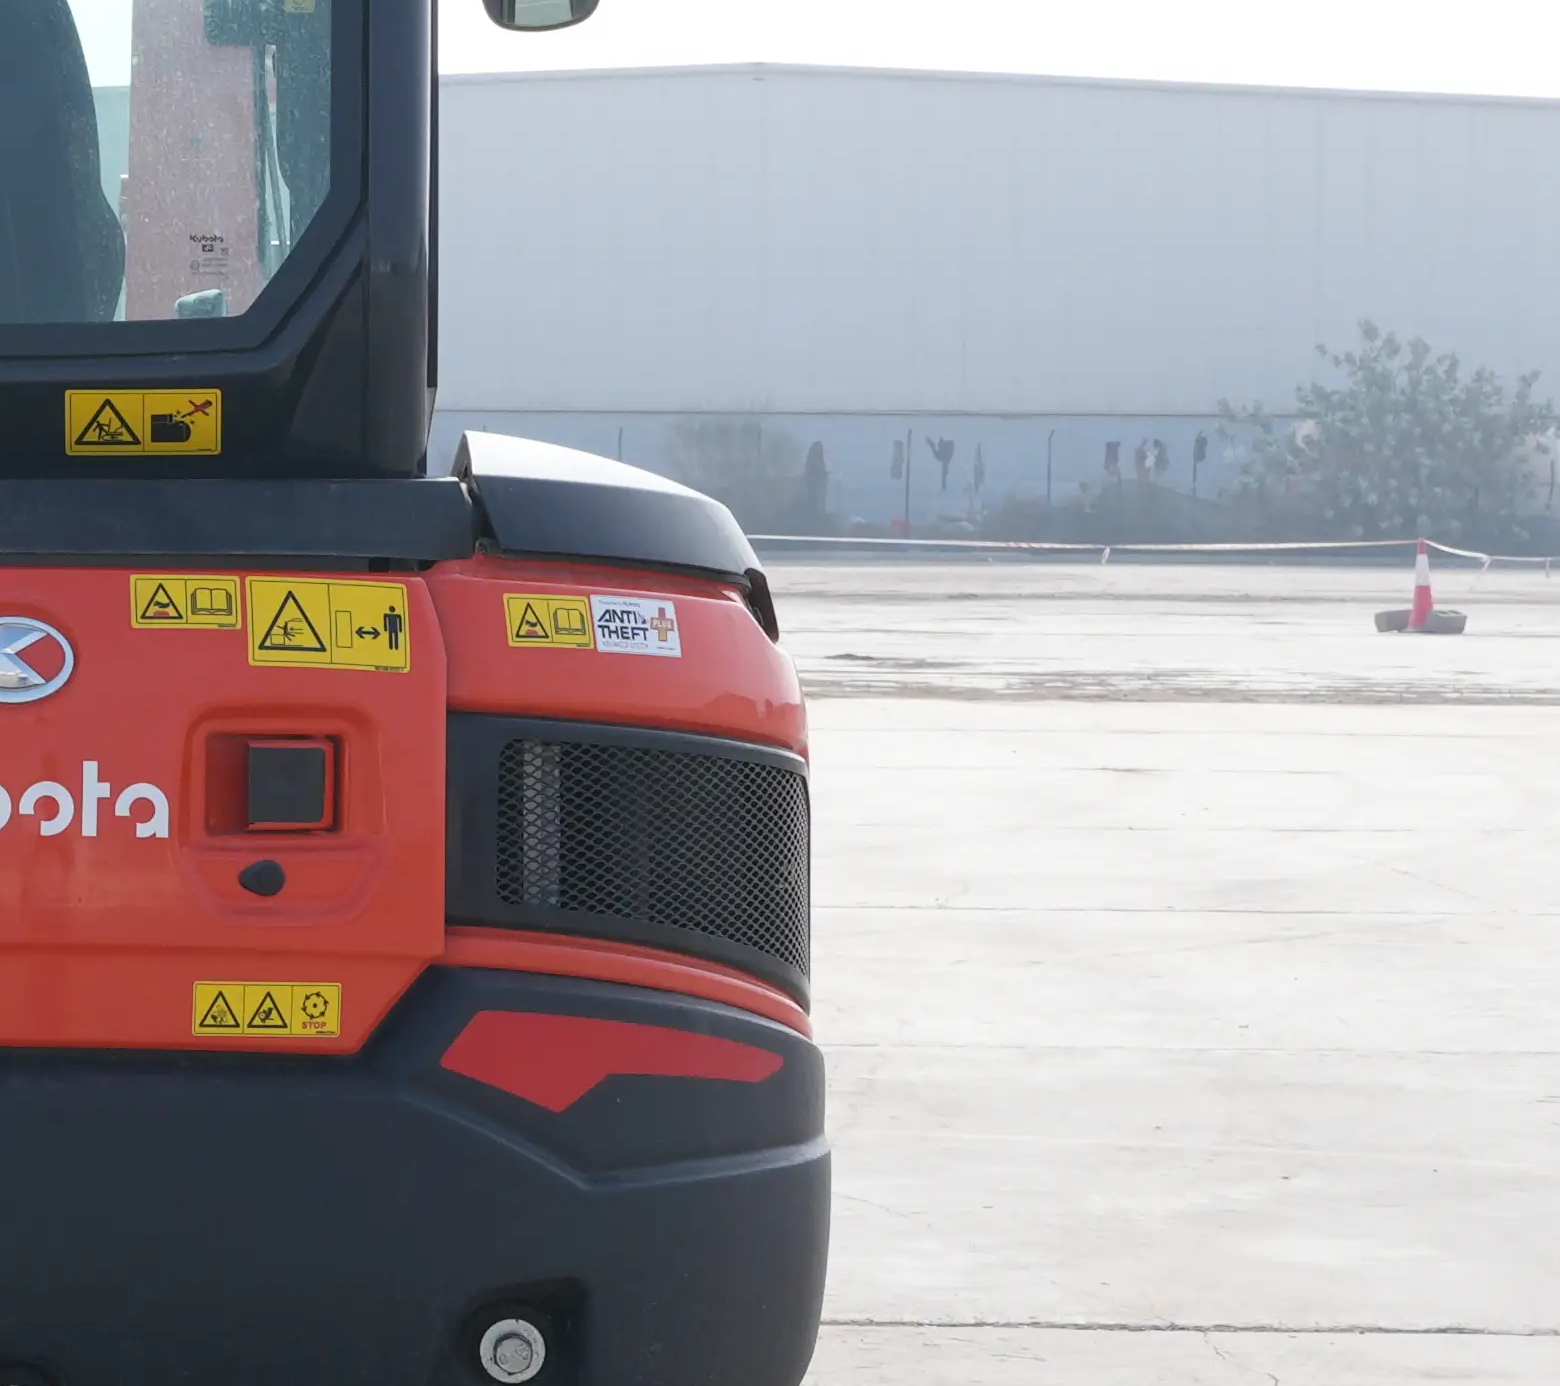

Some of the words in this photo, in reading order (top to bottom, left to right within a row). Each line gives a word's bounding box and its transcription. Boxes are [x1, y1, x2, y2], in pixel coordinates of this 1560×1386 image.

[598, 609, 637, 624] ANTI
[598, 625, 648, 641] THEFT
[302, 1021, 327, 1029] STOP
